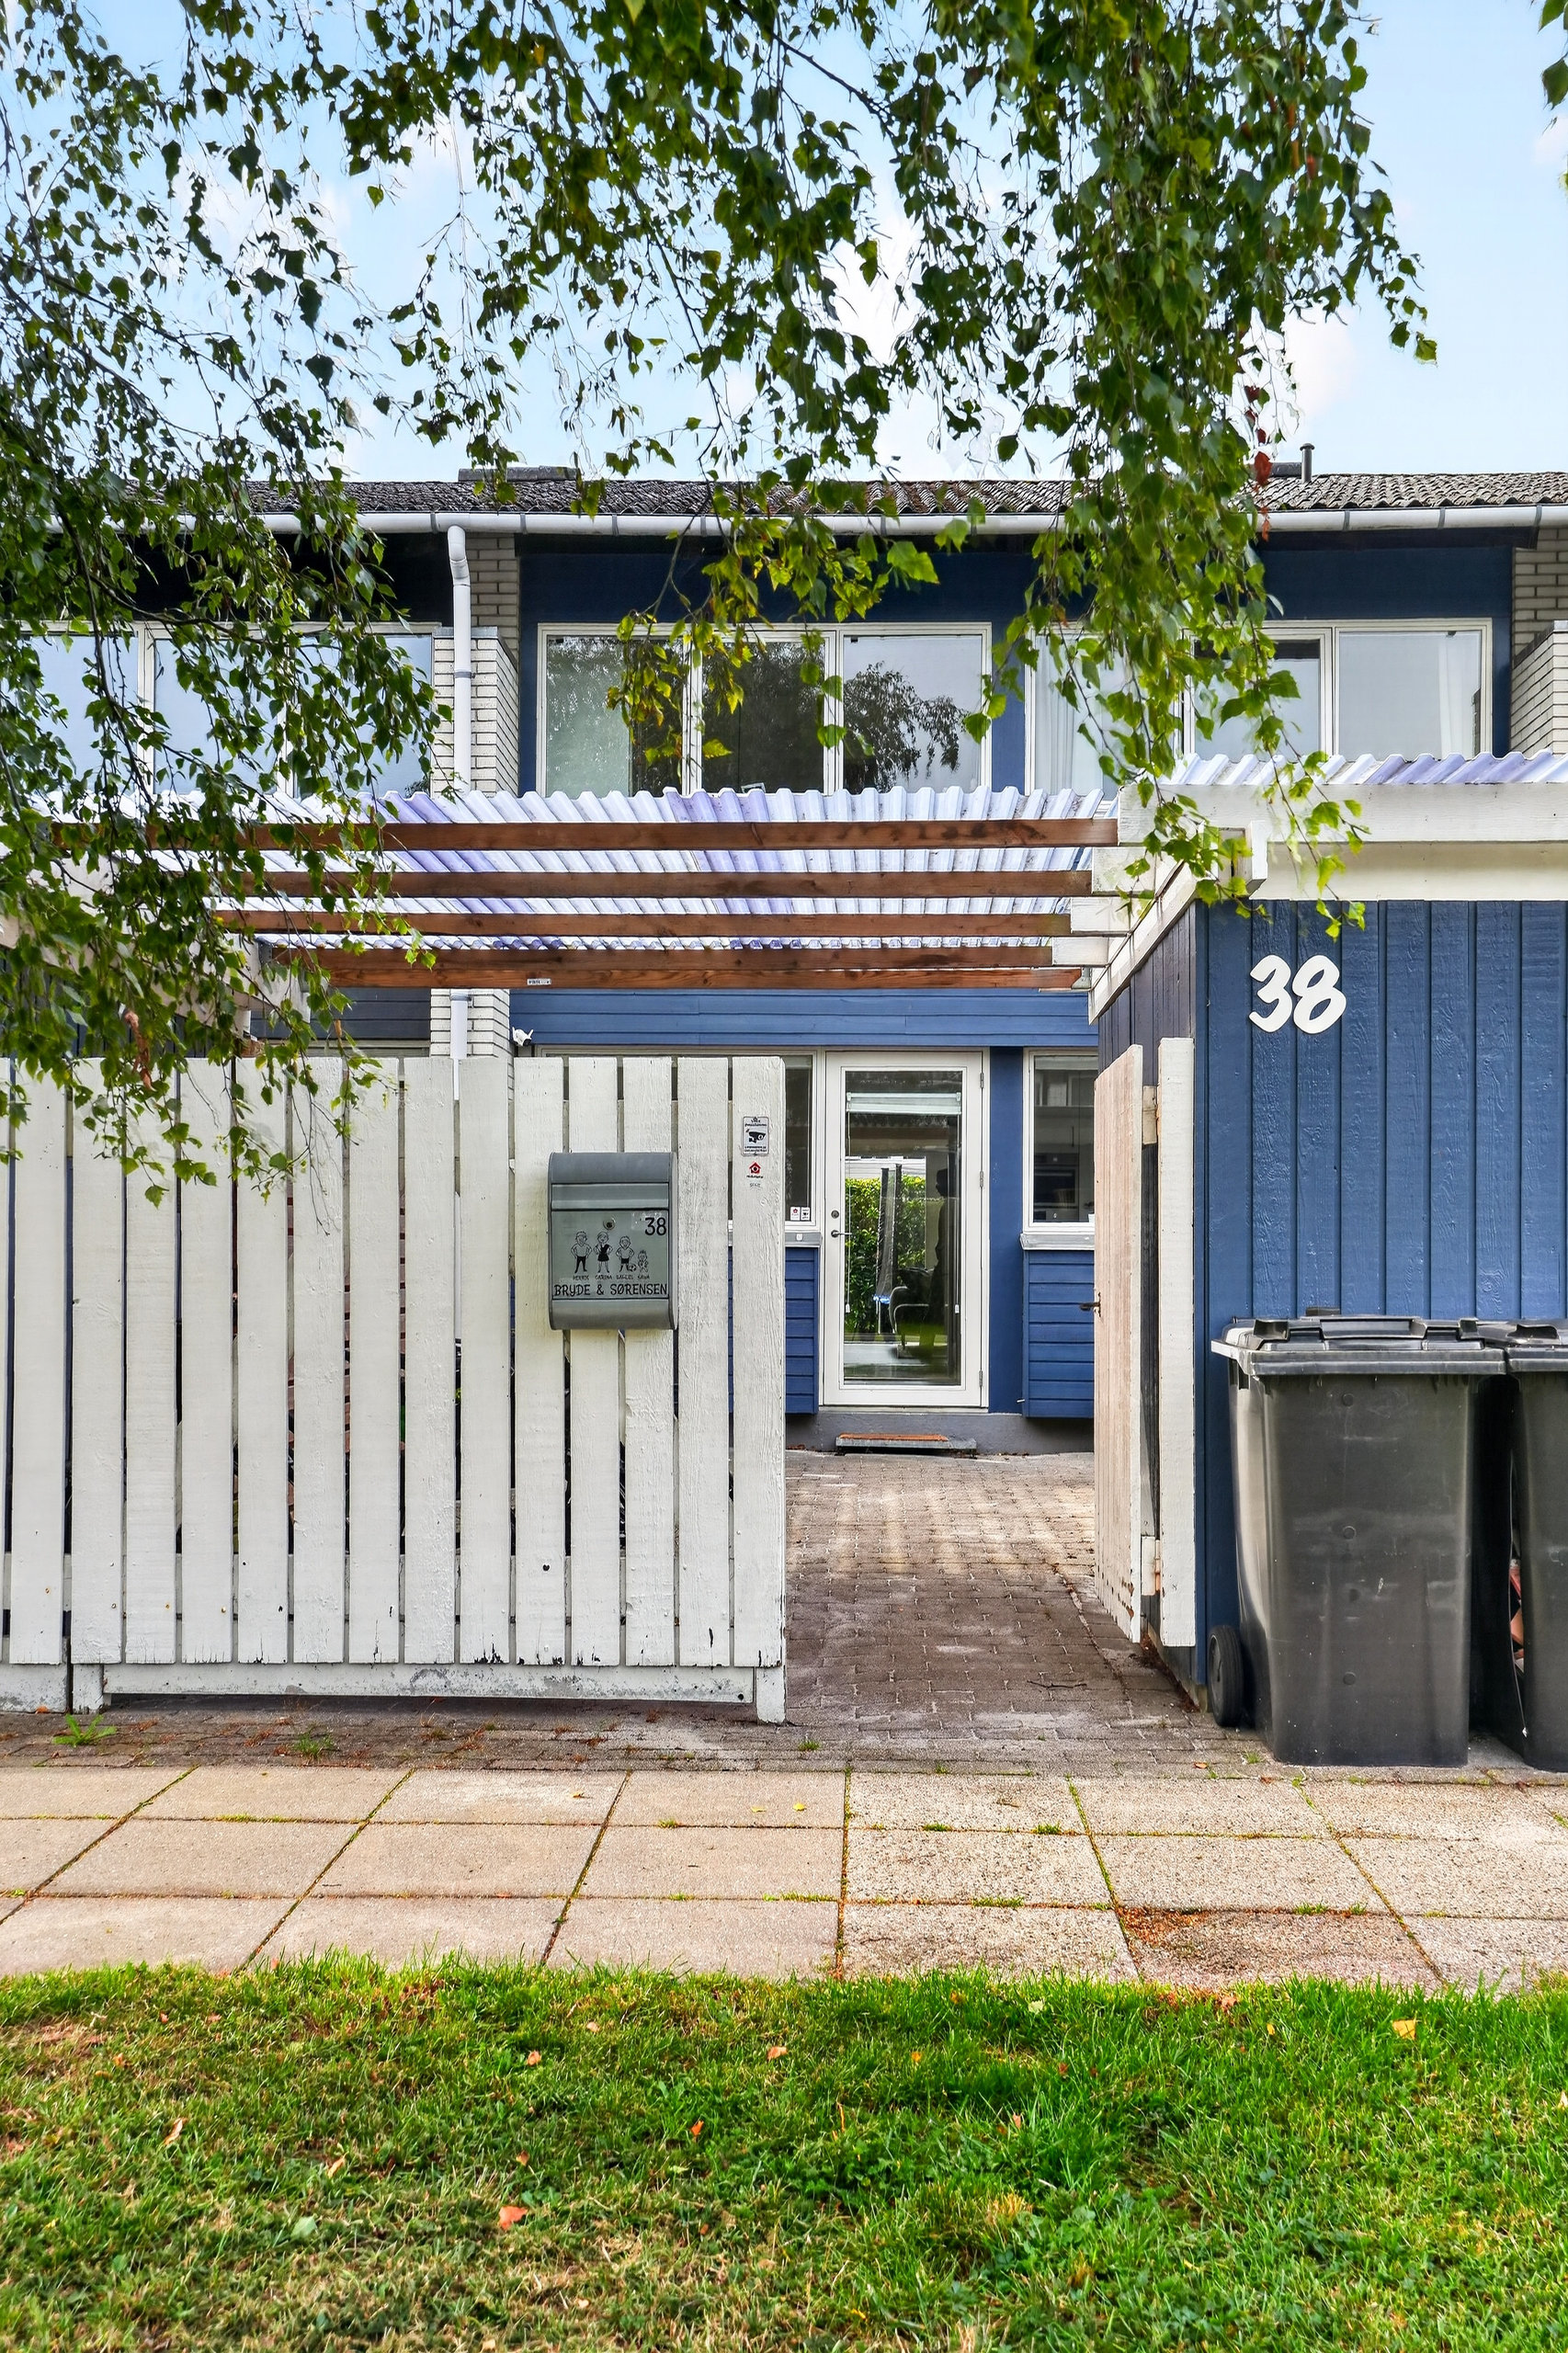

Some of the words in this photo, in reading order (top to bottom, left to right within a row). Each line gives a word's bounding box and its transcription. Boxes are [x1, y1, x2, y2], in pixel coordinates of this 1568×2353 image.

[1249, 954, 1346, 1034] 38
[644, 1217, 667, 1236] 38
[554, 1284, 591, 1297] BRYDE
[597, 1284, 605, 1296] &
[610, 1283, 667, 1296] SØRENSEN
